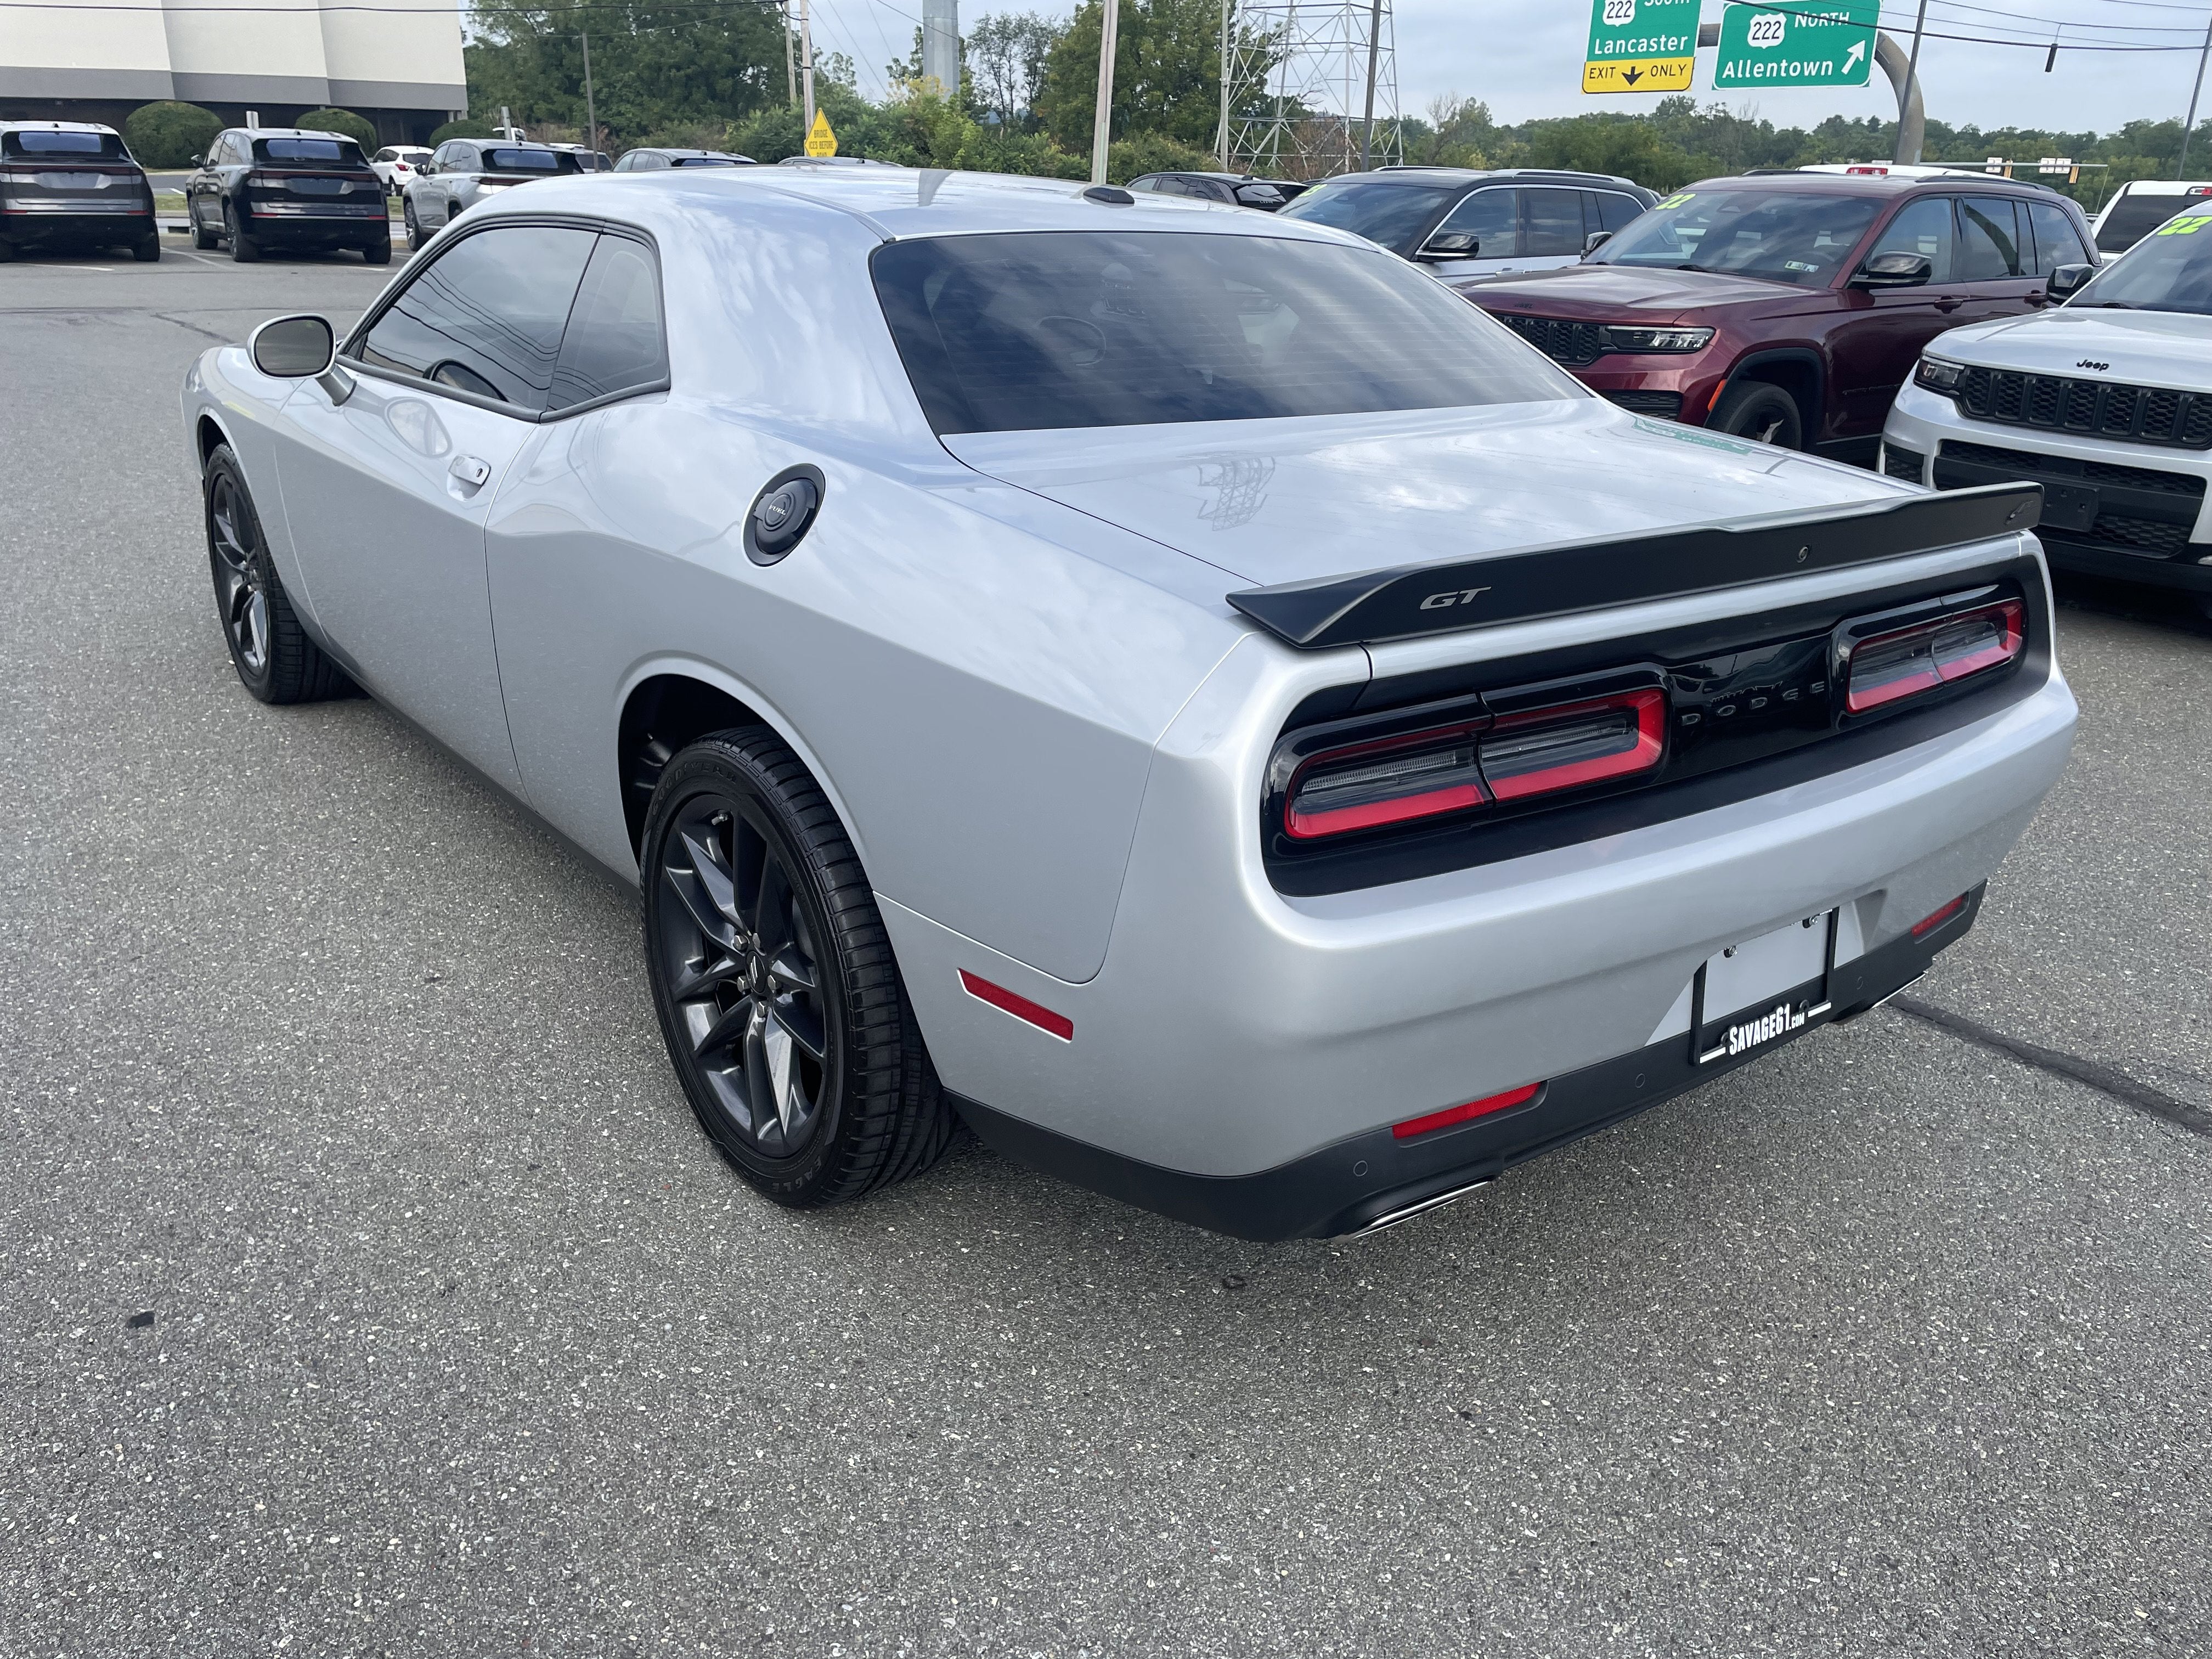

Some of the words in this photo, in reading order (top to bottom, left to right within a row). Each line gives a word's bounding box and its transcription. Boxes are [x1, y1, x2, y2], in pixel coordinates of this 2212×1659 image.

[1606, 0, 1632, 19] 222
[1795, 11, 1850, 27] NORTH
[1752, 21, 1782, 40] 222
[1594, 35, 1688, 54] Lancaster
[1589, 66, 1616, 79] EXIT
[1650, 64, 1687, 77] ONLY
[1722, 59, 1833, 78] Allentown
[809, 141, 818, 149] ICES
[819, 140, 834, 149] BEFORE
[1655, 193, 1696, 210] 22
[2157, 216, 2212, 236] 22
[2076, 359, 2109, 371] Jeep
[769, 505, 786, 515] FUEL
[1419, 586, 1492, 610] GT
[1681, 681, 1825, 726] DODGE
